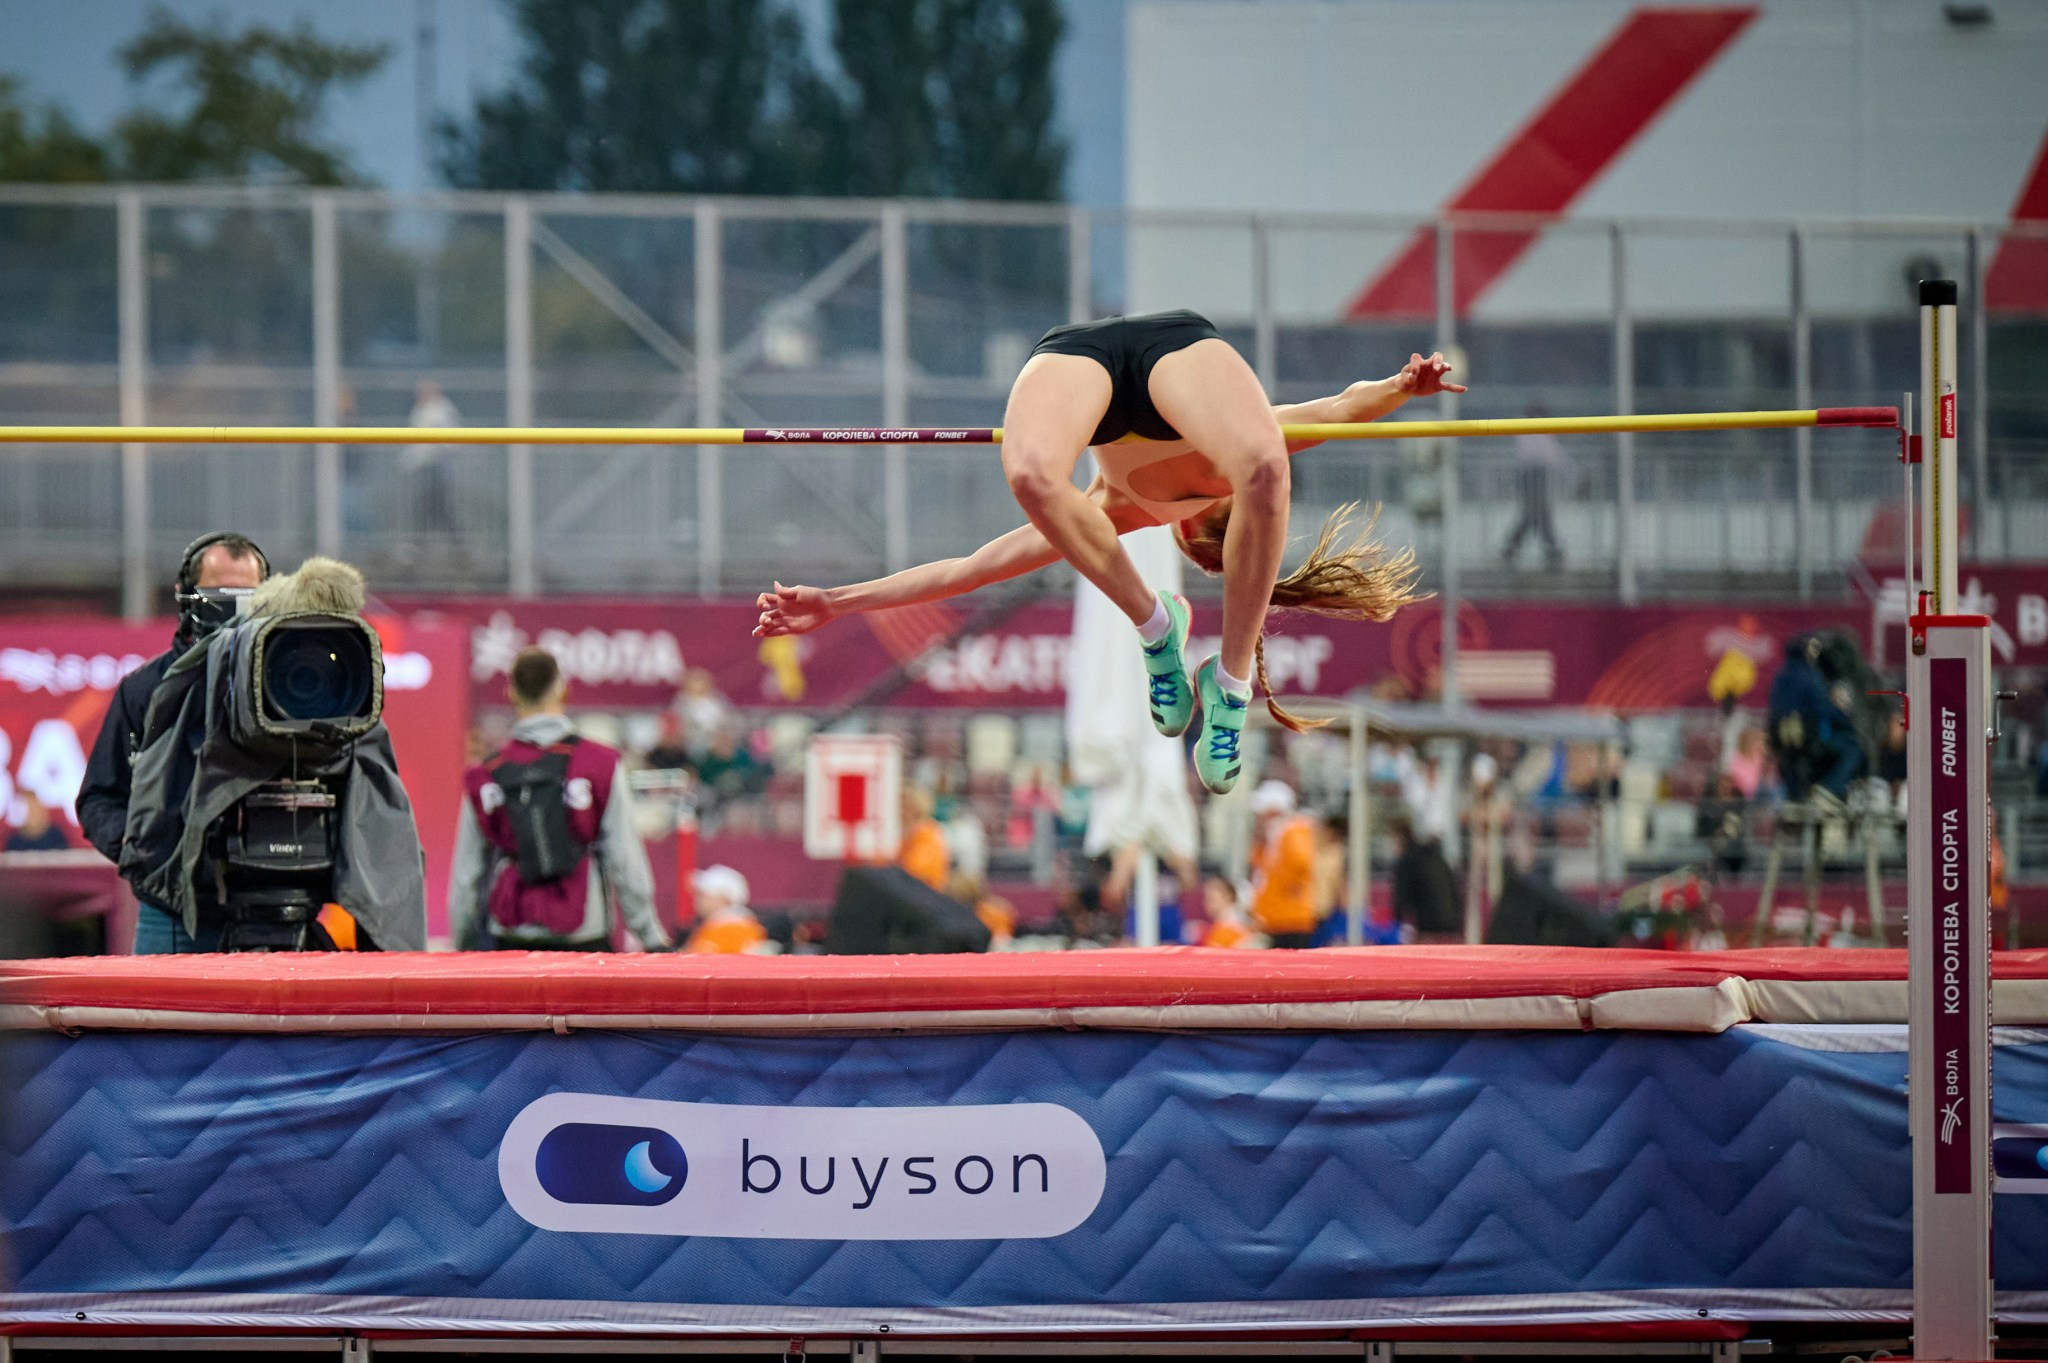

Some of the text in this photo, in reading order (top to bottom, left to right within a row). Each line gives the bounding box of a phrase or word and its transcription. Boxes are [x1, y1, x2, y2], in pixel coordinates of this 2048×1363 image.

[822, 431, 919, 440] КОРОЛЕВА СПОРТА
[934, 431, 968, 439] FONBET
[1945, 399, 1954, 434] polanik
[1942, 707, 1957, 776] FONBET
[1942, 808, 1960, 1014] КОРОЛЕВА СПОРТА
[1946, 1049, 1958, 1095] ВФЛА
[741, 1138, 1049, 1209] buyson
